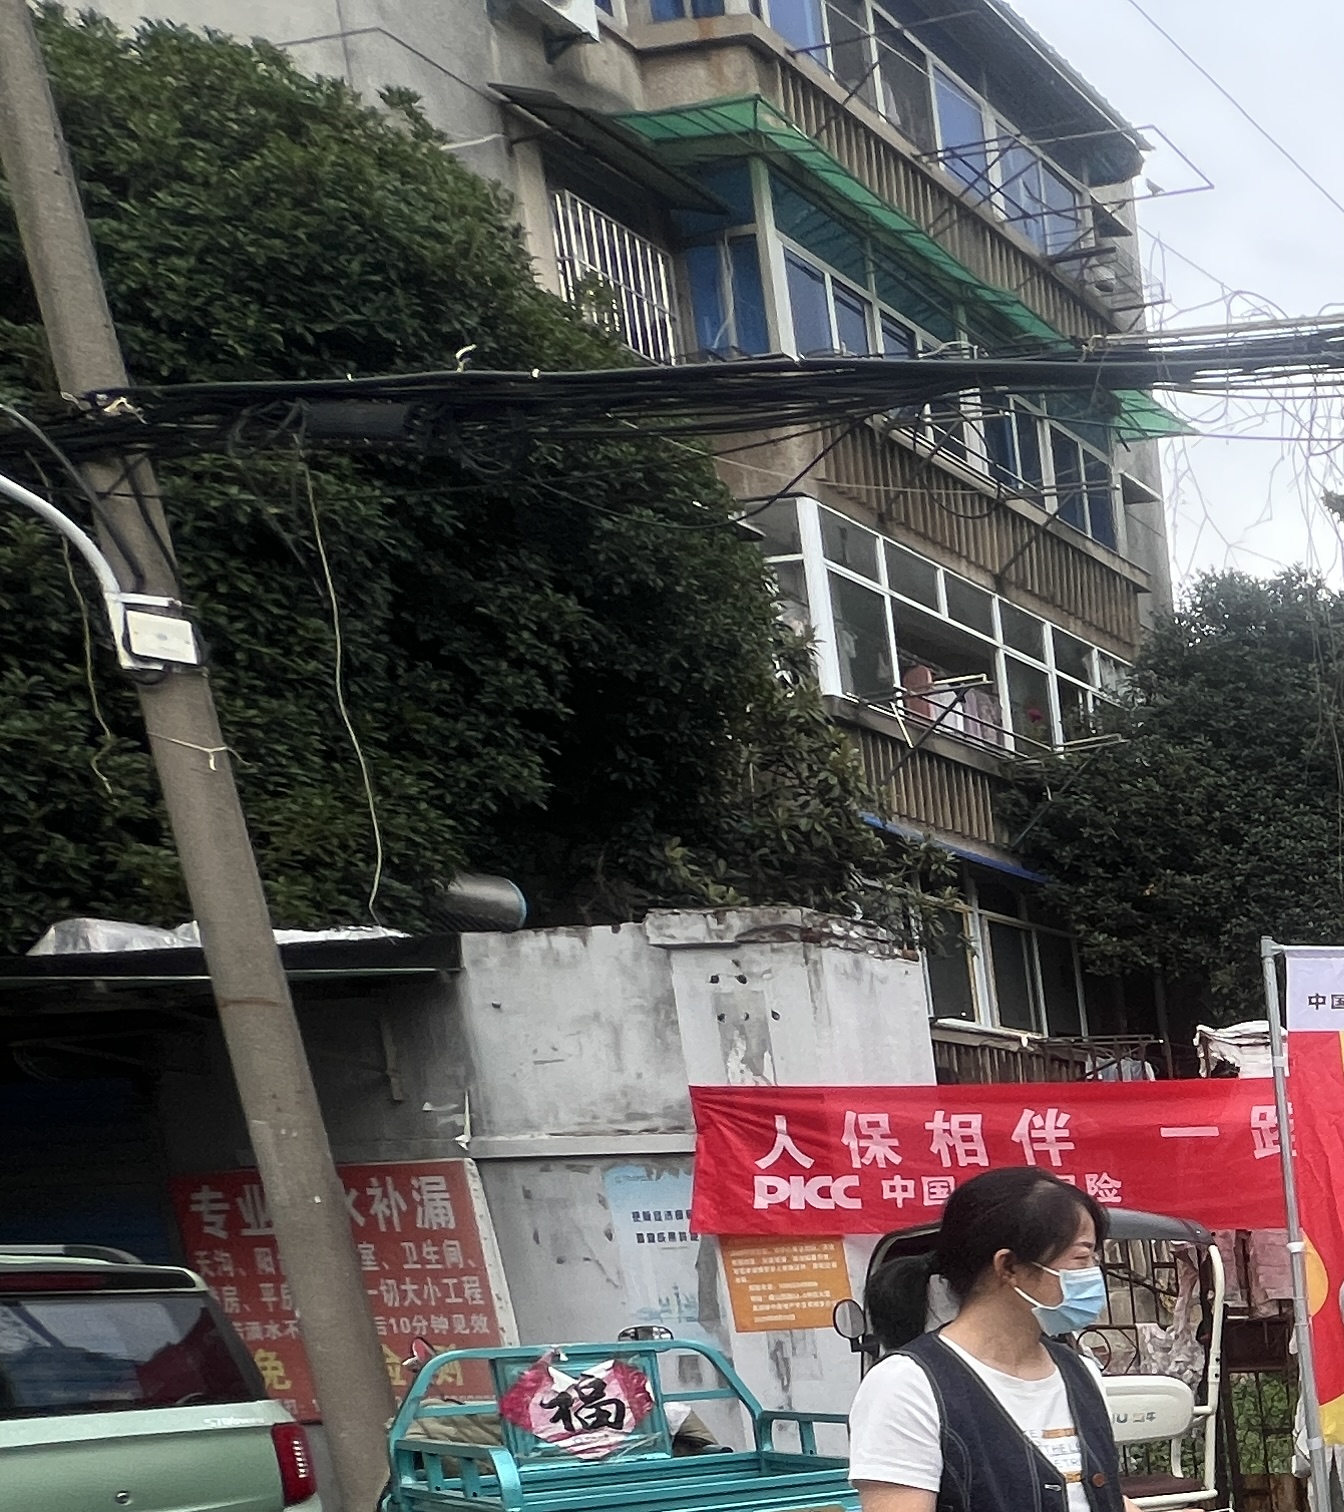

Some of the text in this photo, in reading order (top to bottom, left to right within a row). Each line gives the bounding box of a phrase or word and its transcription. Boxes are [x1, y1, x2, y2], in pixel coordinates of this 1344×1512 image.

[754, 1108, 1076, 1170] 人保相伴
[189, 1175, 455, 1240] 专业补漏
[753, 1172, 1122, 1210] PICC 中国险
[540, 1373, 627, 1433] 福
